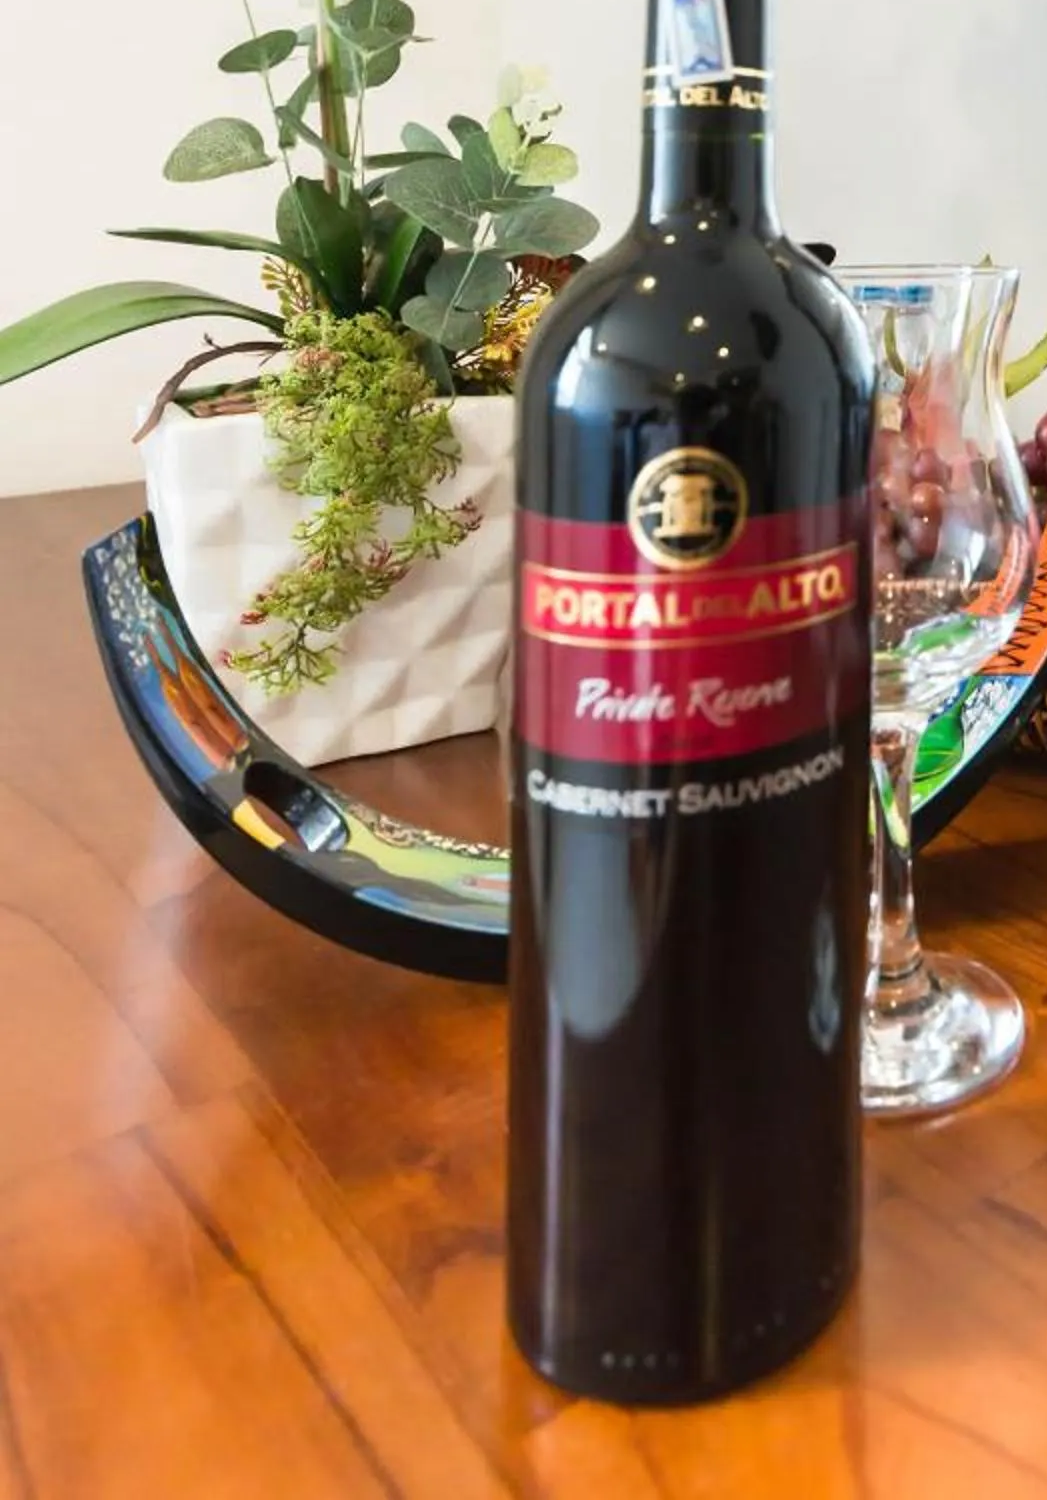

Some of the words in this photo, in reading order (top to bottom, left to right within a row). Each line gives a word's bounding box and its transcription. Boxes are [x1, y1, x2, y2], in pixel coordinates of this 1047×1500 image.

[534, 583, 689, 629] PORTAL
[747, 564, 840, 619] ALTO
[575, 676, 675, 722] Private
[526, 768, 672, 818] CABERNET
[677, 746, 845, 814] SAUVIGNON
